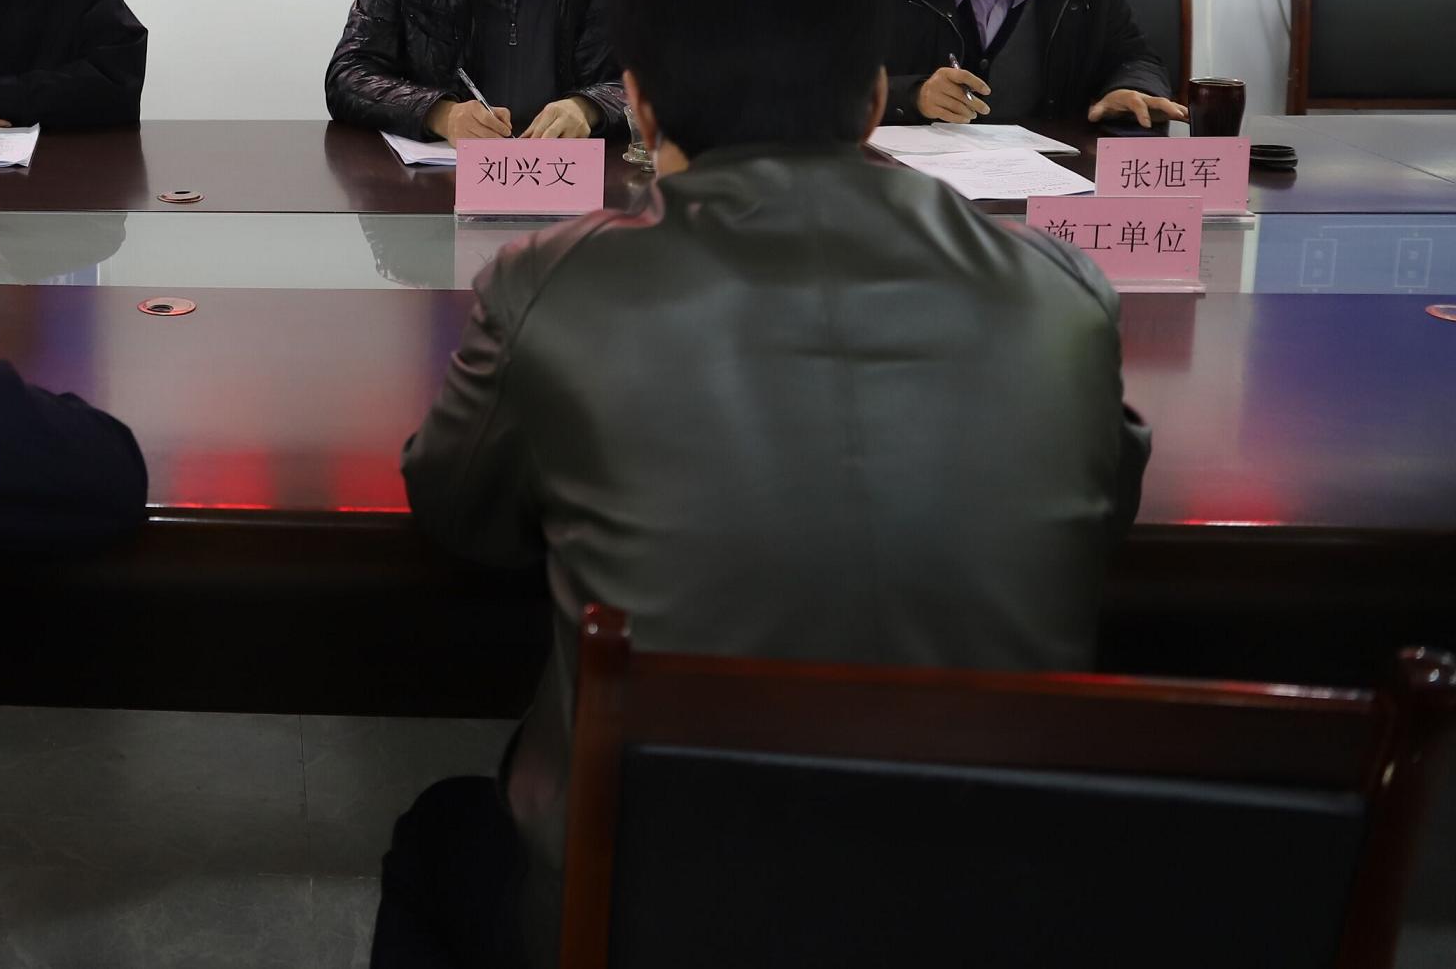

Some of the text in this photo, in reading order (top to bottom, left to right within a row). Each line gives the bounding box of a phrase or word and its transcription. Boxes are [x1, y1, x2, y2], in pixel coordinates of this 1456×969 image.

[477, 156, 577, 186] 刘兴文
[1120, 157, 1221, 189] 张旭军
[1044, 219, 1187, 253] 施工单位
